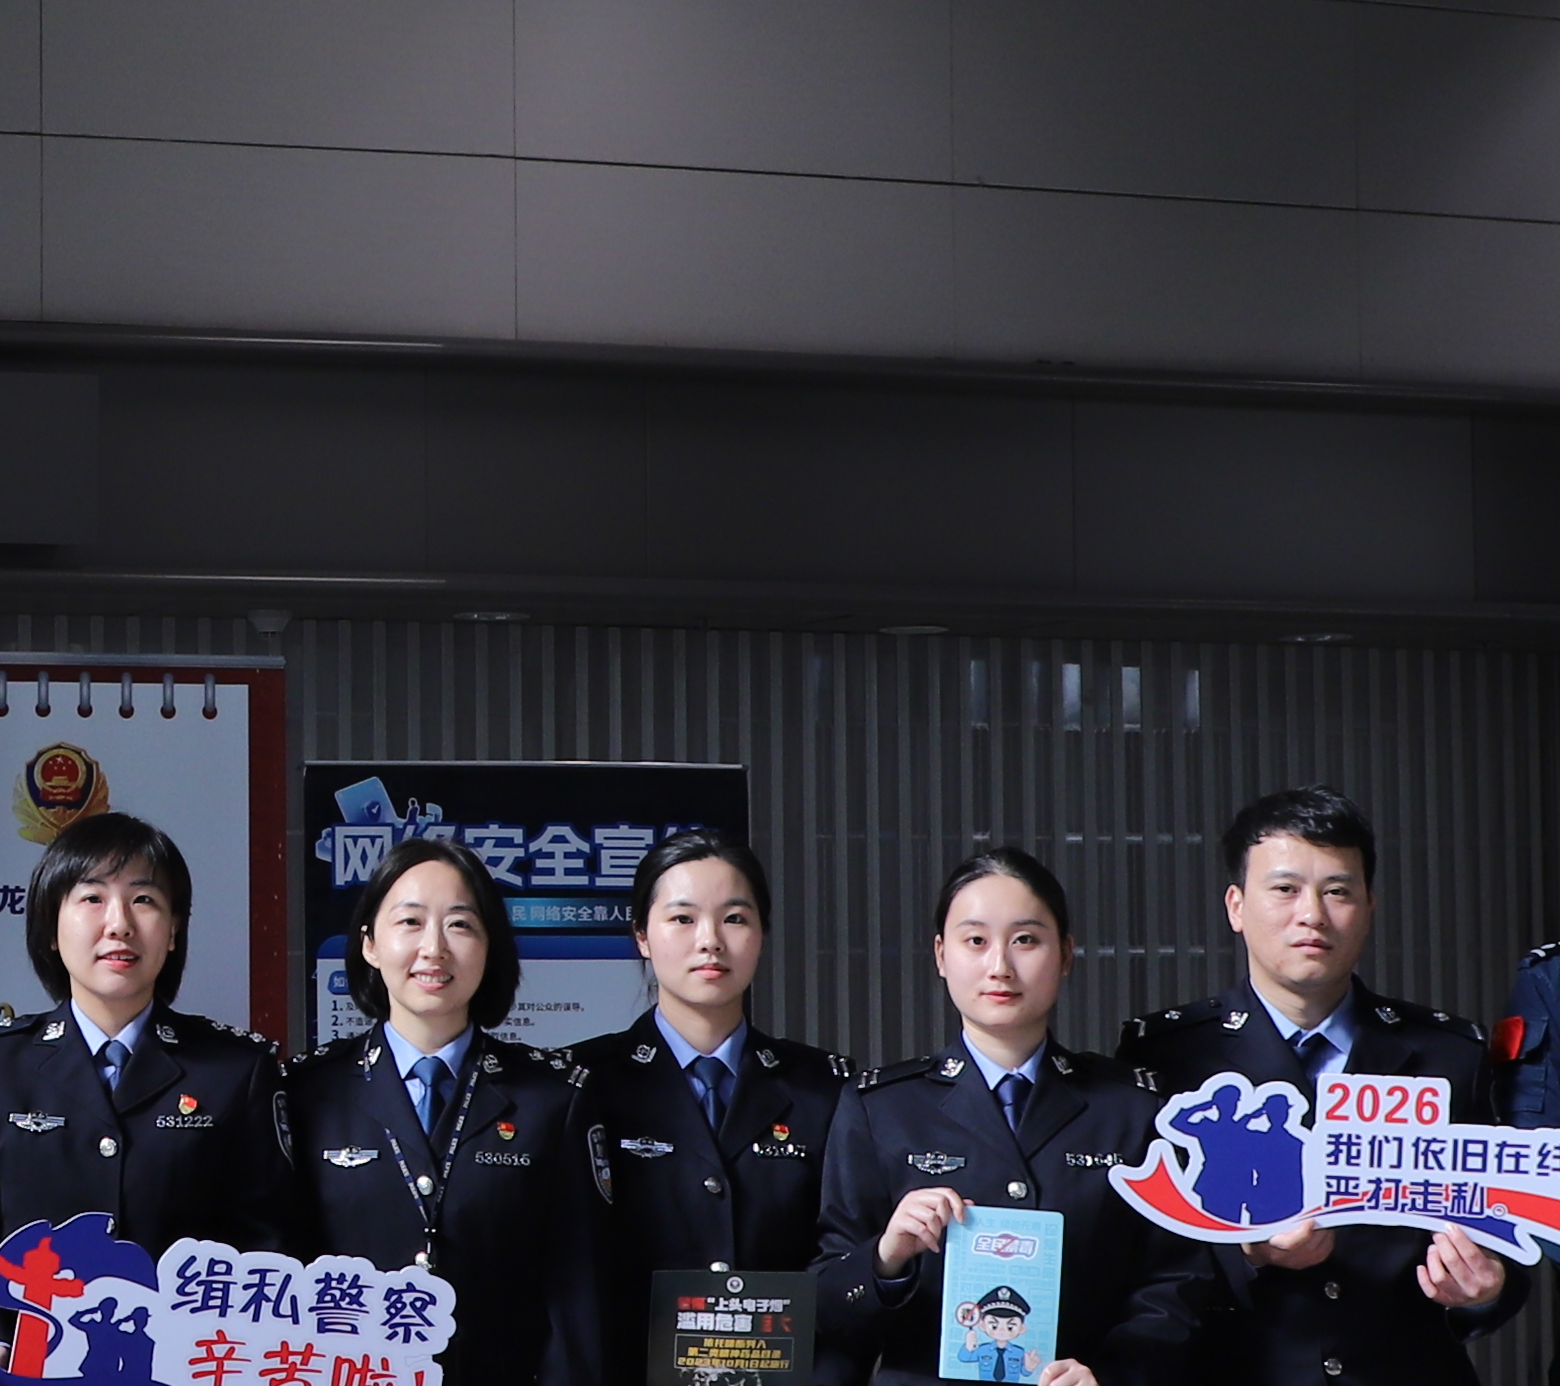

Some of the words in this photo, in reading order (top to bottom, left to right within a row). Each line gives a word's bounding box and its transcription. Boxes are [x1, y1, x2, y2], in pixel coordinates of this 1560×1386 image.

[334, 823, 709, 887] 网安全宣
[1325, 1083, 1441, 1125] 2026
[1323, 1175, 1509, 1219] 严打走私。
[171, 1254, 438, 1345] 缉私警察
